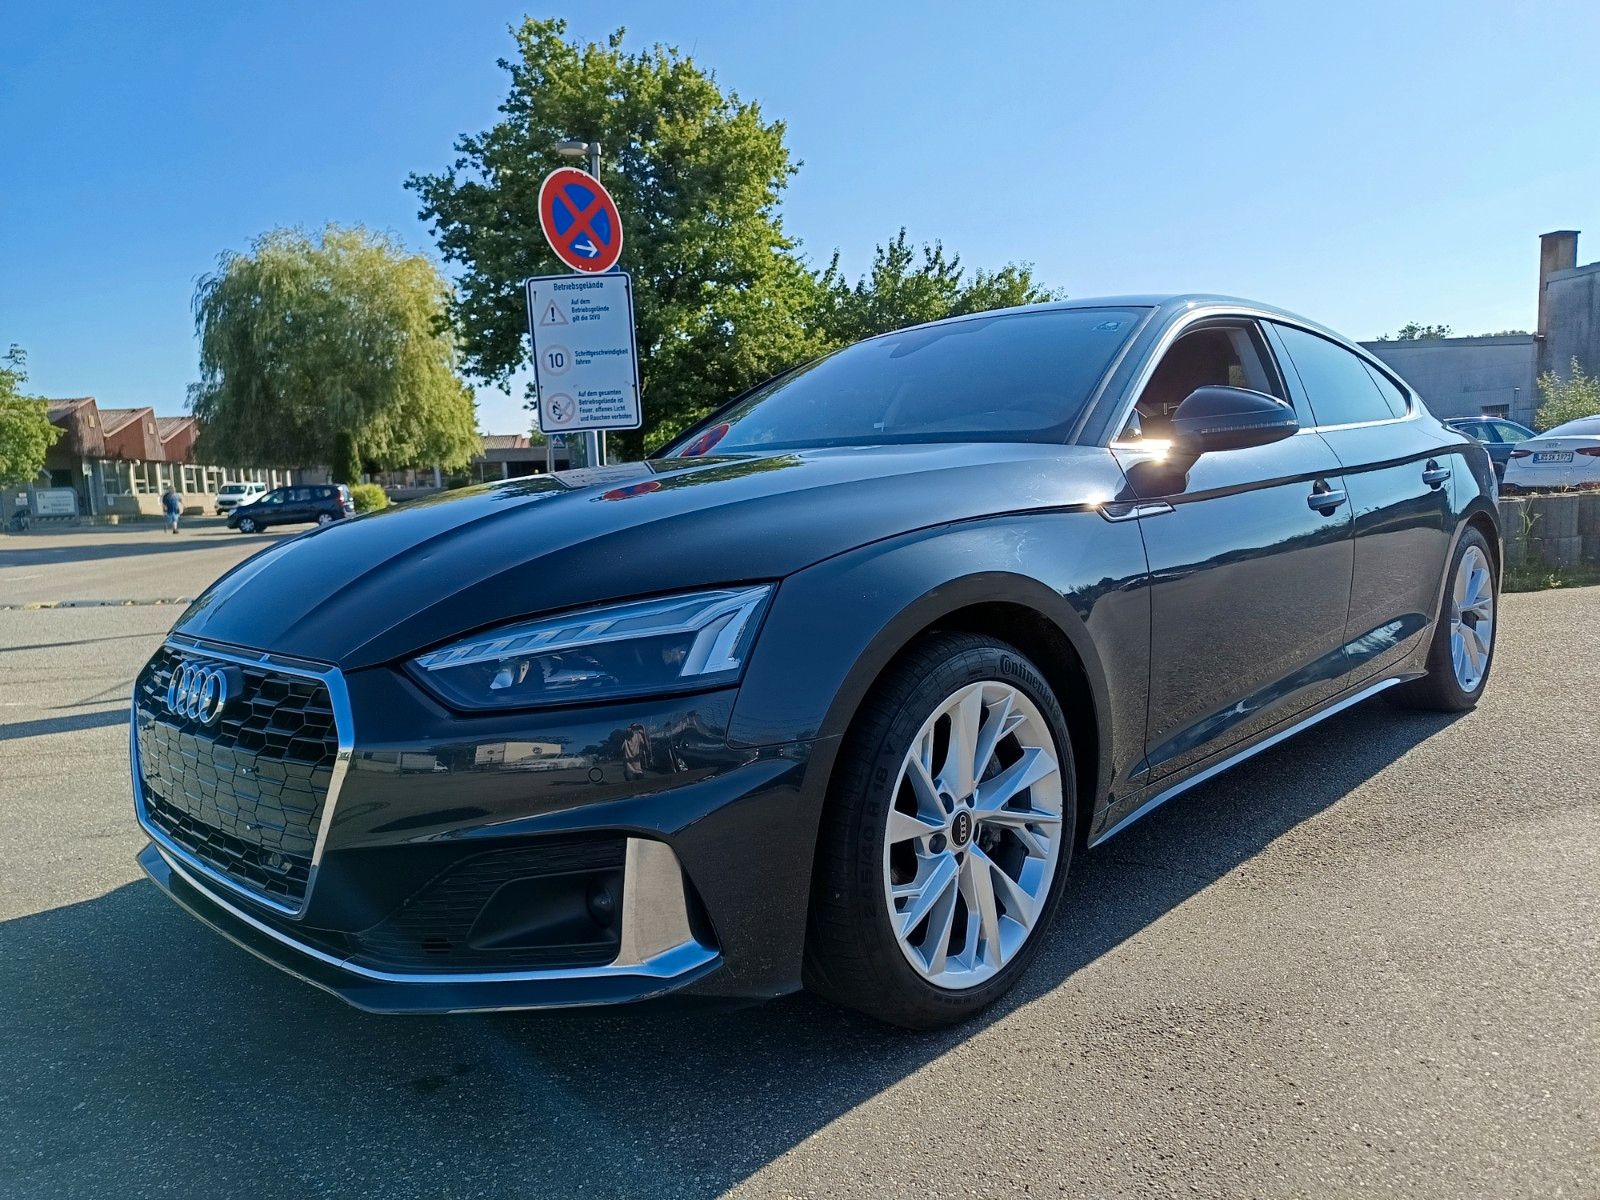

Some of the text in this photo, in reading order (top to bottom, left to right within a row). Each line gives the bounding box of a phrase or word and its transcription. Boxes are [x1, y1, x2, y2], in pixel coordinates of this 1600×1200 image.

[553, 281, 604, 291] Betriebsgelände
[548, 353, 564, 368] 10
[598, 389, 621, 397] gesamten
[1000, 654, 1055, 711] Continental
